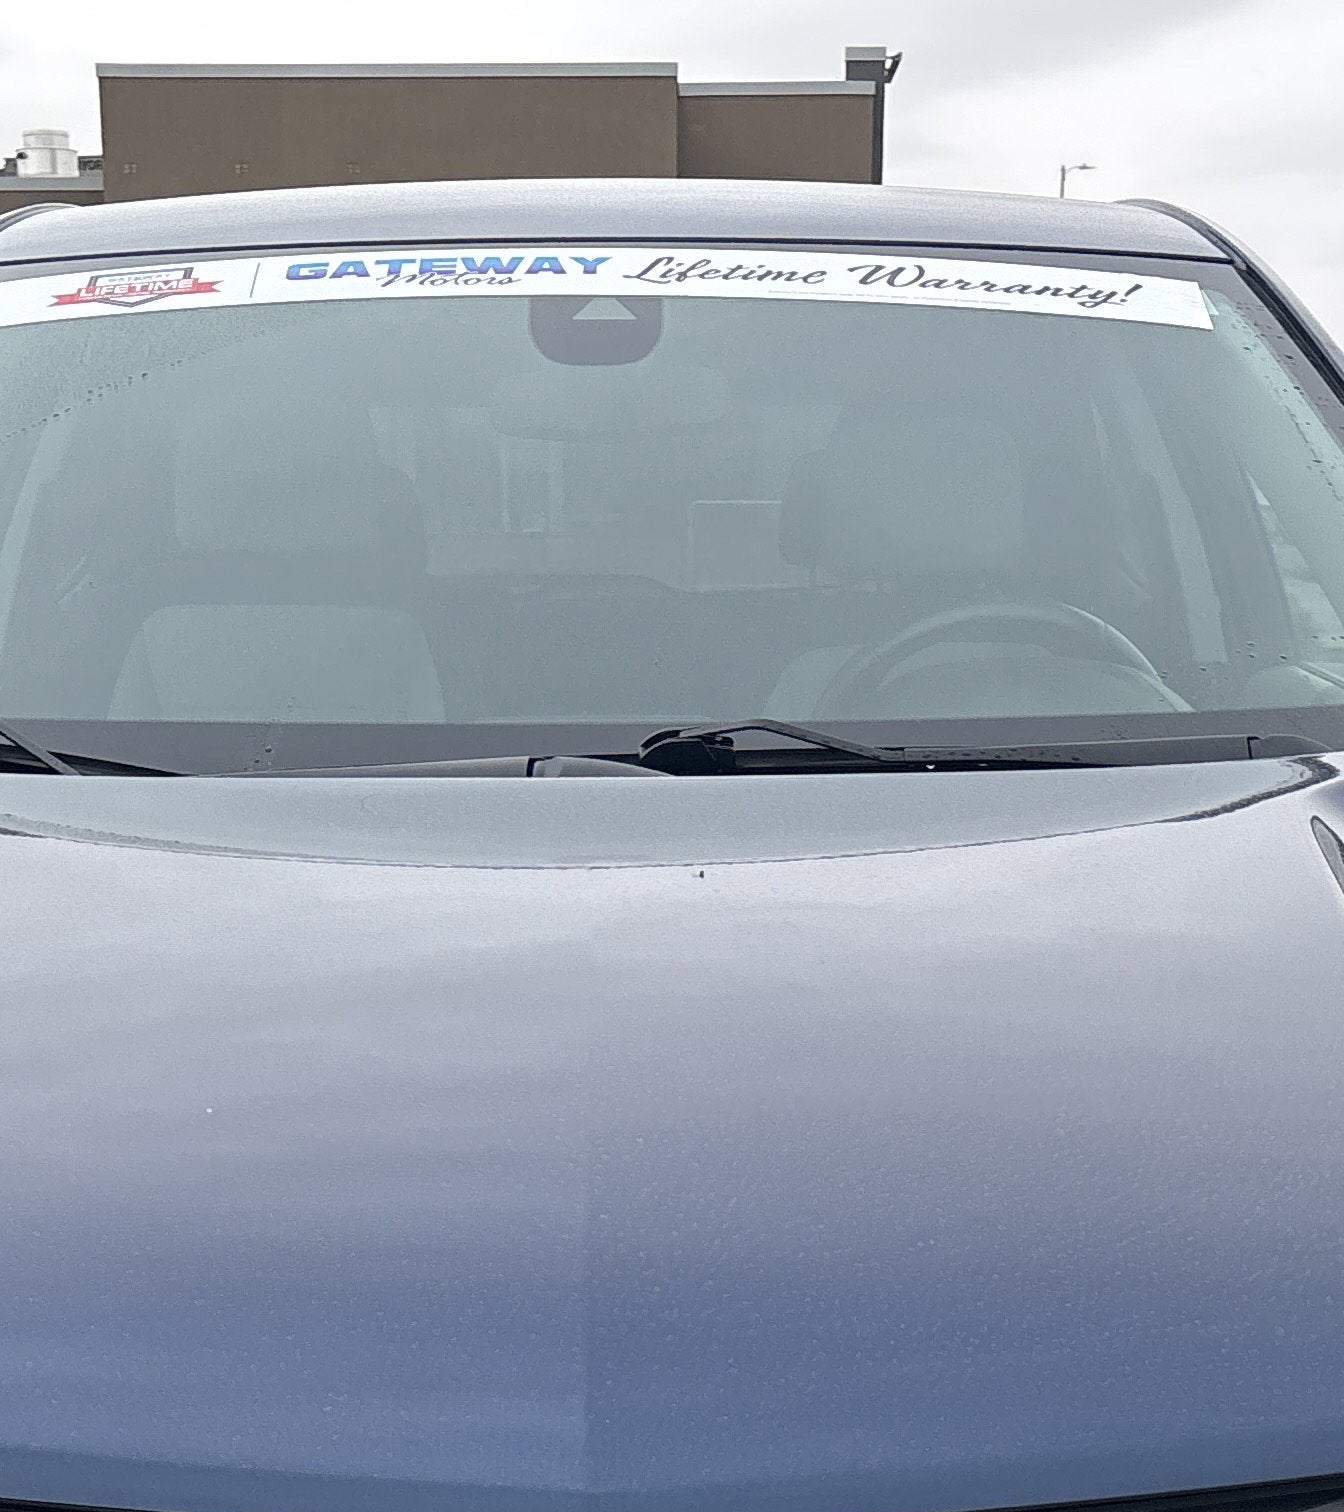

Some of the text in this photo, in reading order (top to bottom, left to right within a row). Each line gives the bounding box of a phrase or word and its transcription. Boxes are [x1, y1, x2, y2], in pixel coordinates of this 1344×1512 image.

[285, 256, 613, 281] GATEWAY
[375, 271, 522, 288] Motors
[79, 278, 195, 297] LIFETIME
[623, 256, 826, 285] Lifetime
[847, 263, 1144, 308] Warranty!
